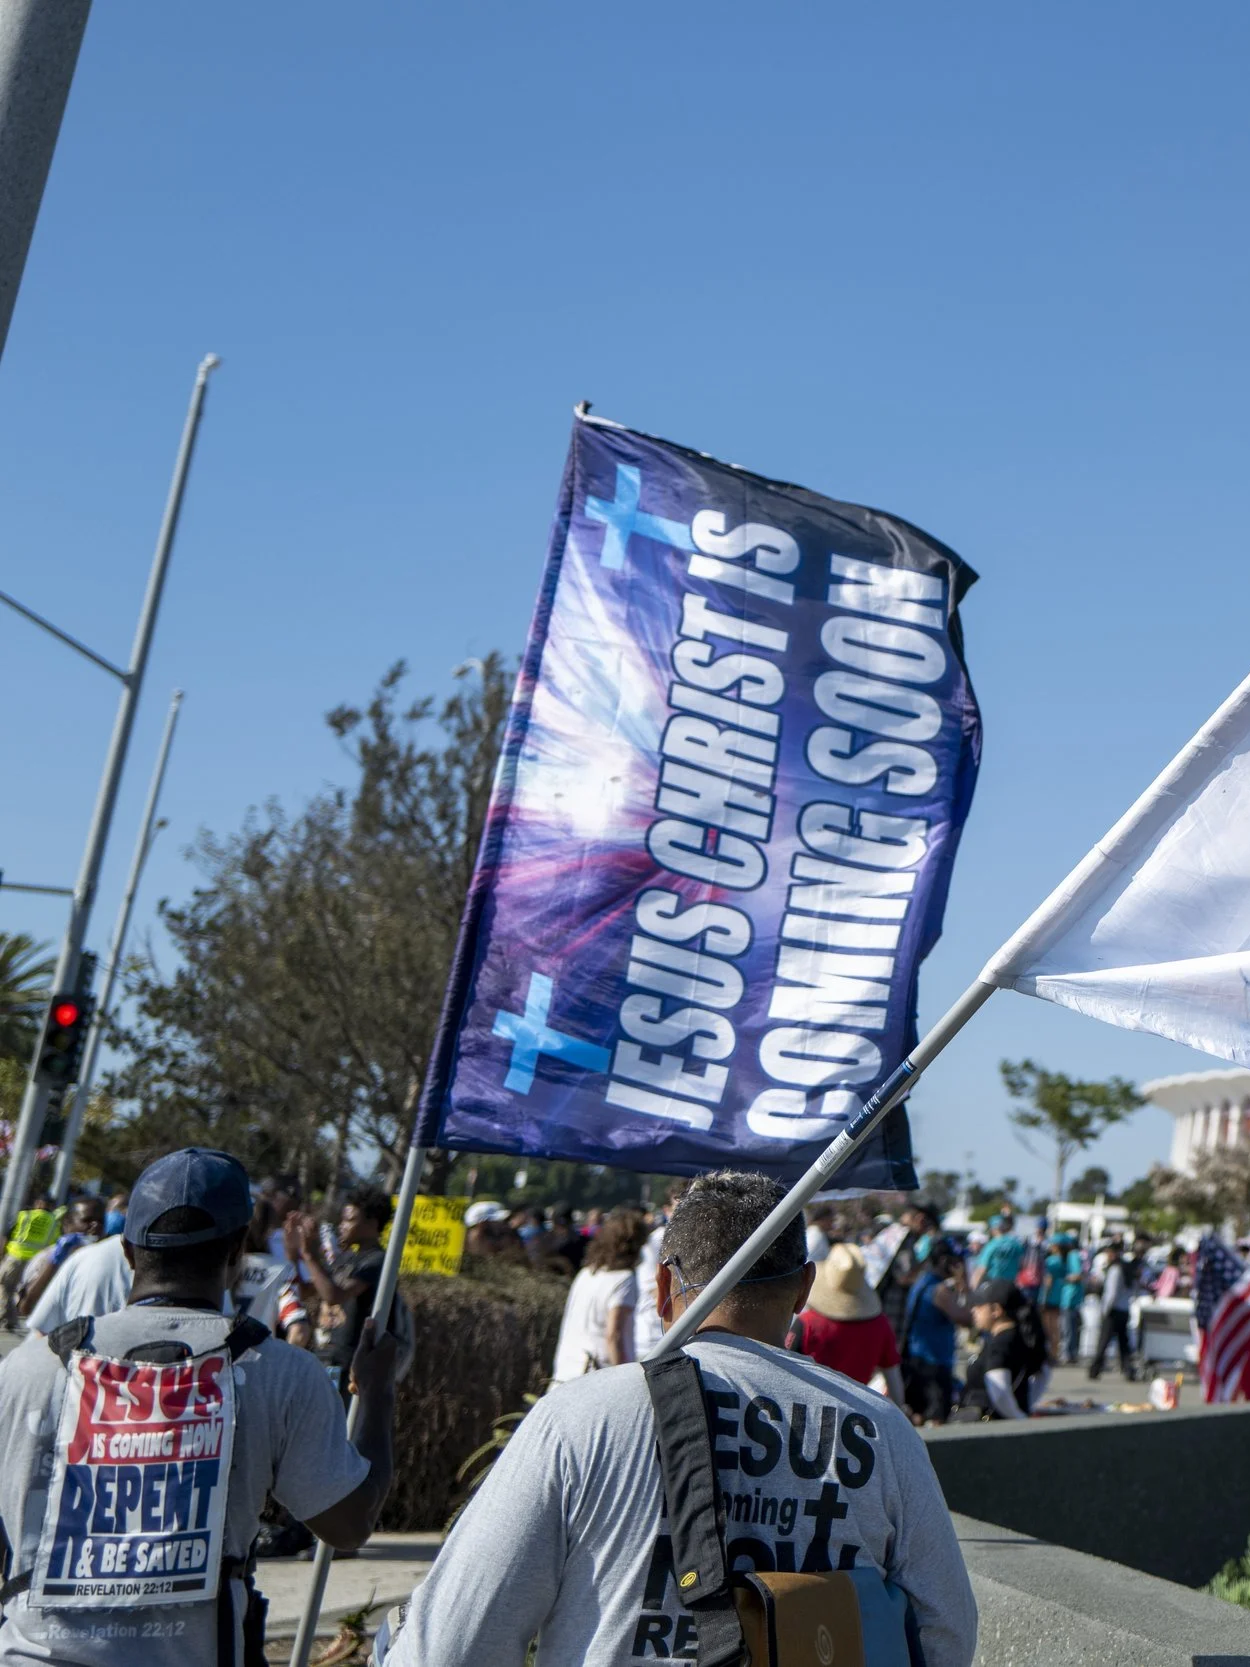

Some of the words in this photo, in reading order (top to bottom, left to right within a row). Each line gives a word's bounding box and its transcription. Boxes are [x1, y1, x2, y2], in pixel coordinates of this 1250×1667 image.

[687, 509, 800, 606] IS
[806, 553, 947, 796] SOON
[648, 593, 789, 892] CHRIST
[605, 889, 753, 1131] JESUS
[746, 801, 928, 1141] COMING
[67, 1356, 224, 1465] JESUS
[92, 1432, 105, 1459] IS
[109, 1430, 175, 1459] COMING
[179, 1421, 222, 1458] NOW
[704, 1389, 877, 1489] ESUS
[46, 1459, 220, 1579] REPENT
[75, 1537, 95, 1578] &
[100, 1542, 131, 1573] BE
[134, 1538, 207, 1573] SAVED
[723, 1487, 799, 1536] ming
[76, 1583, 141, 1597] REVELATION
[142, 1581, 173, 1595] 22:12
